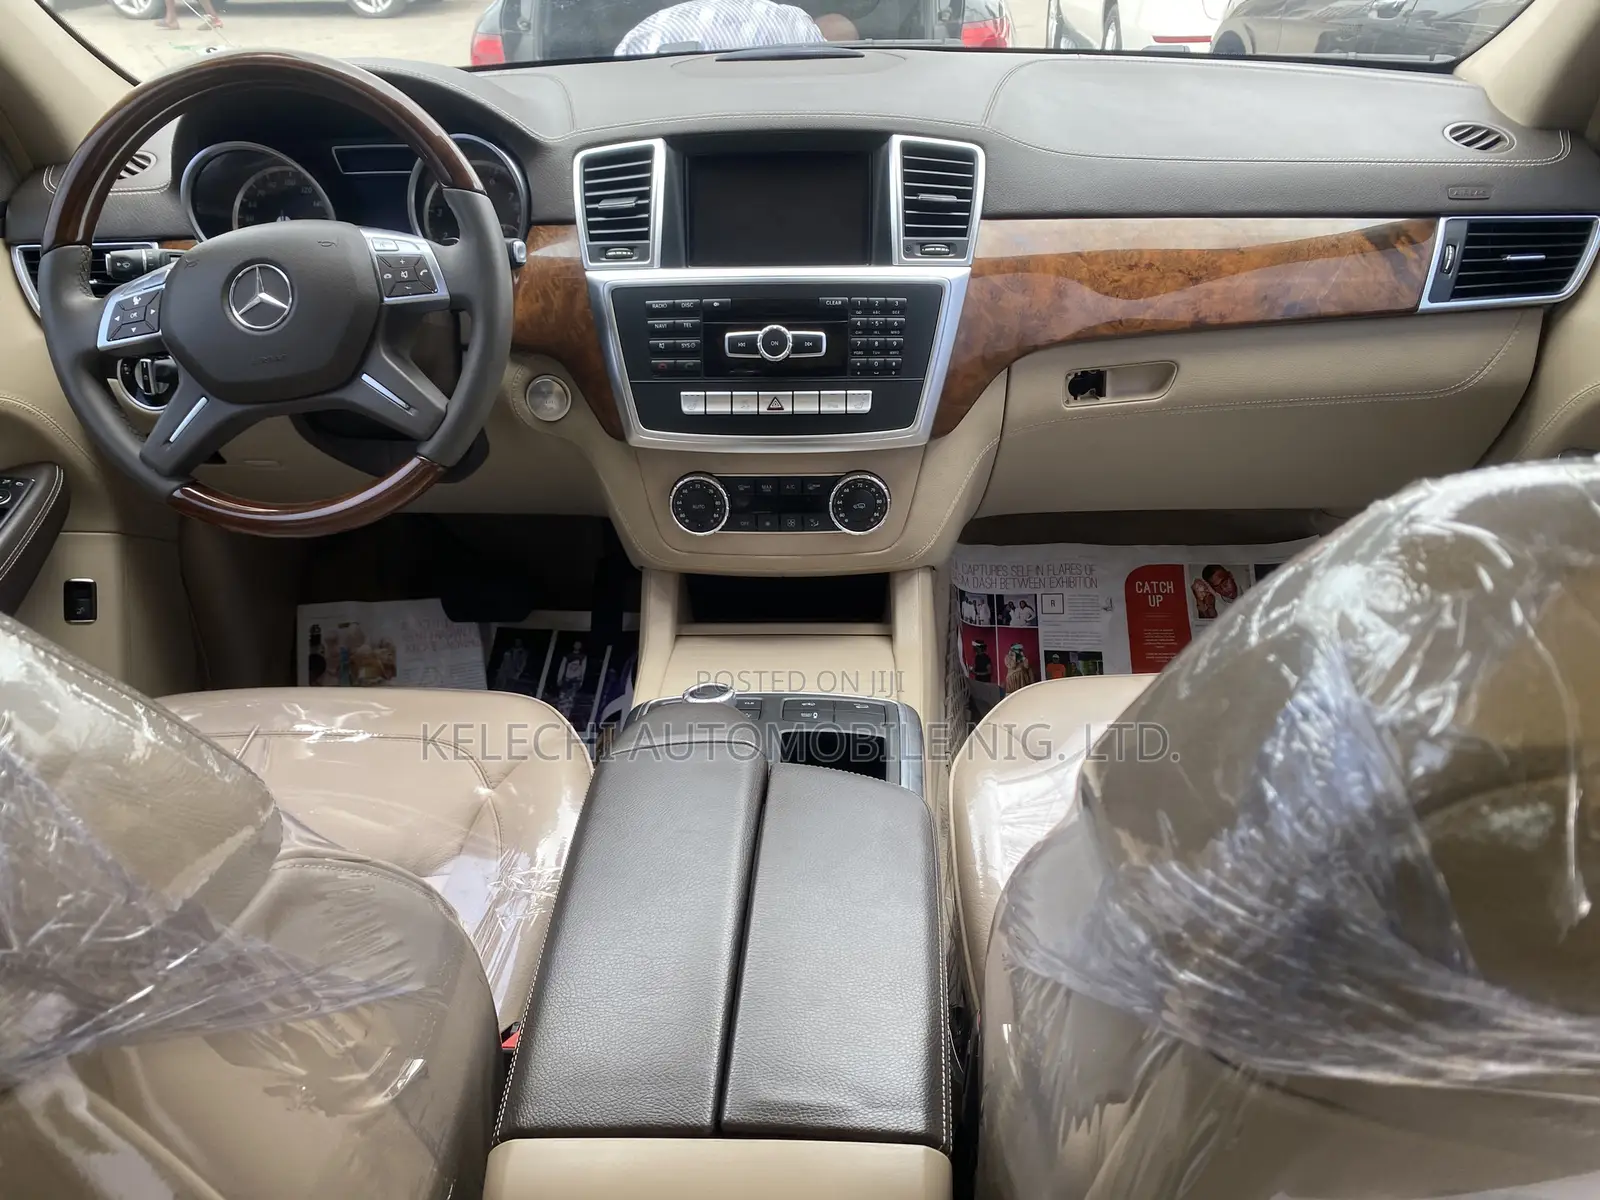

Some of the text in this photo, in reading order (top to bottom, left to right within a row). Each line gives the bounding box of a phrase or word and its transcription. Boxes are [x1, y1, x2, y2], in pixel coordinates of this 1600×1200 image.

[961, 563, 1008, 578] CAPTURES
[1010, 564, 1034, 578] SELF
[1035, 564, 1044, 576] IN
[1047, 563, 1082, 576] FLARES
[1084, 563, 1098, 576] OF
[972, 576, 998, 589] DASH
[999, 577, 1046, 590] BETWEEN
[1049, 576, 1098, 589] EXHIBITION
[1135, 581, 1175, 594] CATCH
[1050, 599, 1056, 607] R
[1147, 594, 1164, 607] UP
